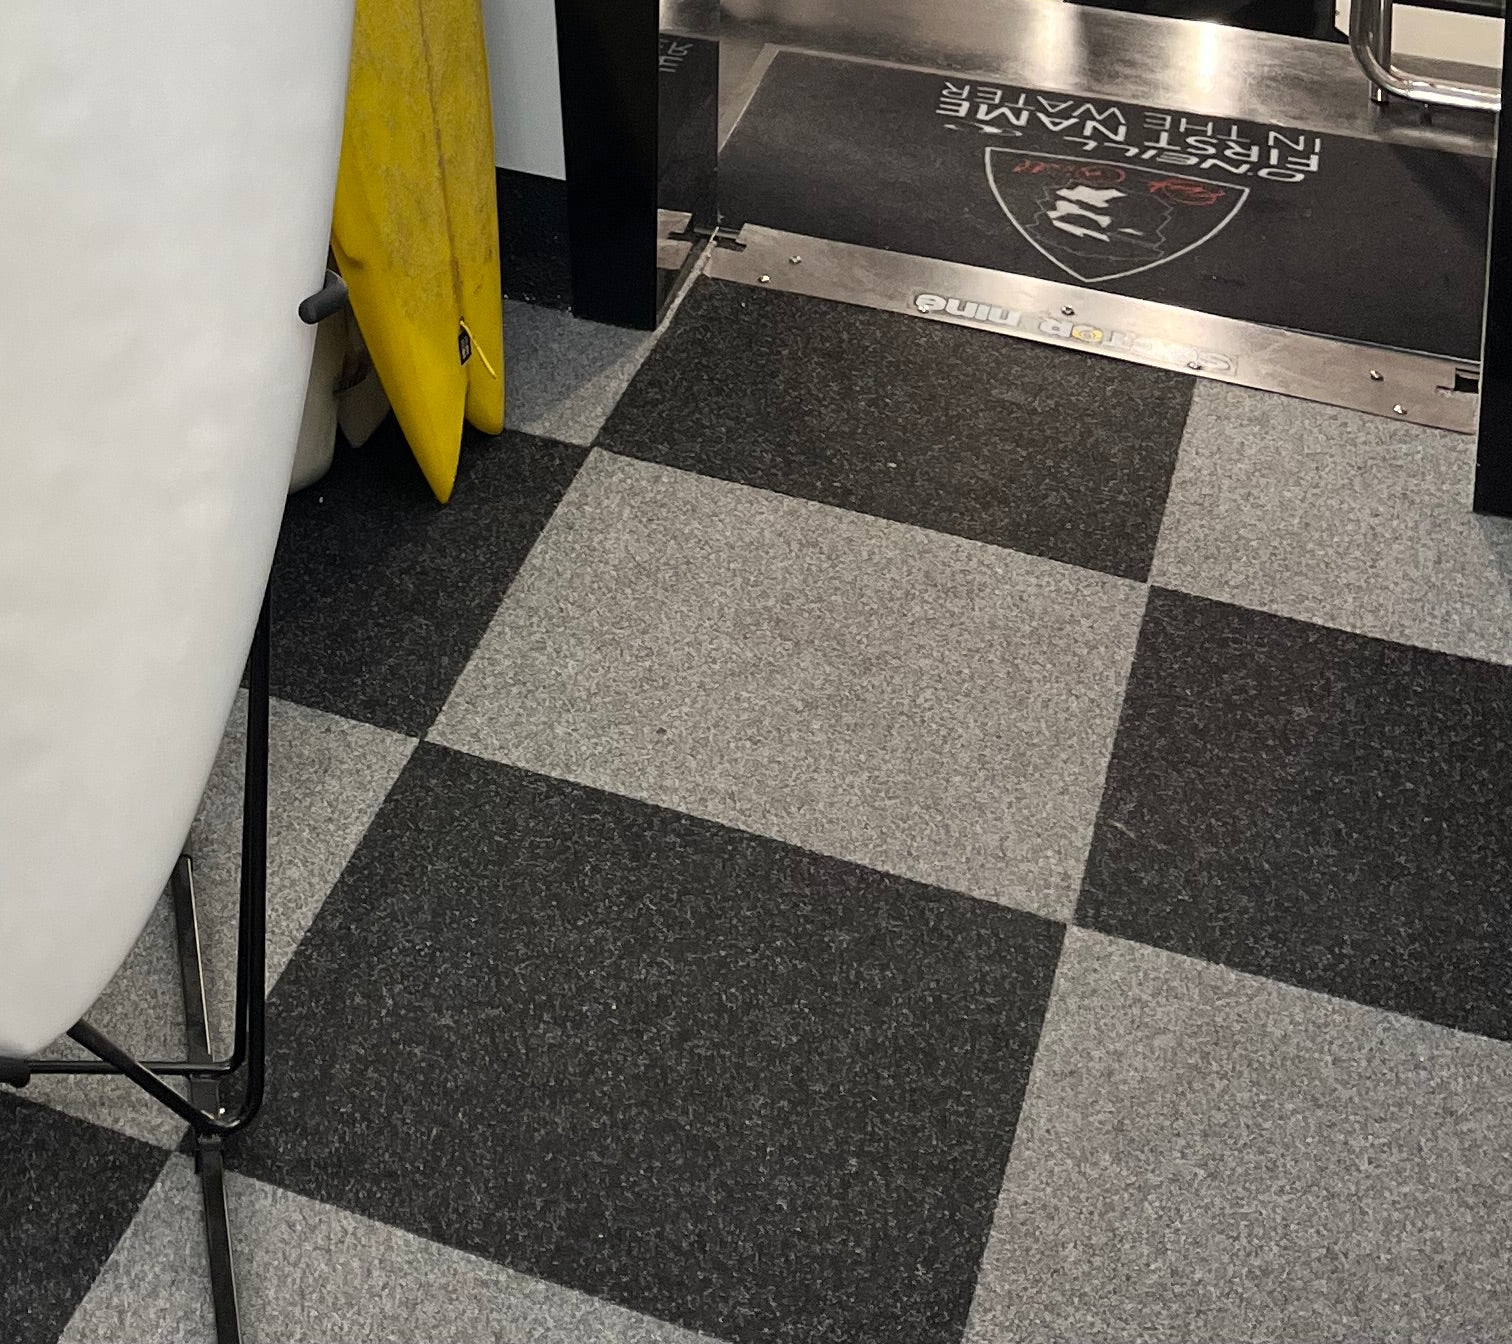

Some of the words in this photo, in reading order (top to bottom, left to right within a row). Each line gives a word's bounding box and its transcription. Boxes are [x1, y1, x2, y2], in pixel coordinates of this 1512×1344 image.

[934, 97, 1127, 142] NAME
[940, 81, 1126, 125] WATER
[1143, 111, 1251, 144] THE
[1268, 130, 1322, 154] IN
[1063, 136, 1306, 183] O'NEILL
[1144, 133, 1320, 173] FIRST
[1039, 320, 1234, 372] SCTOR
